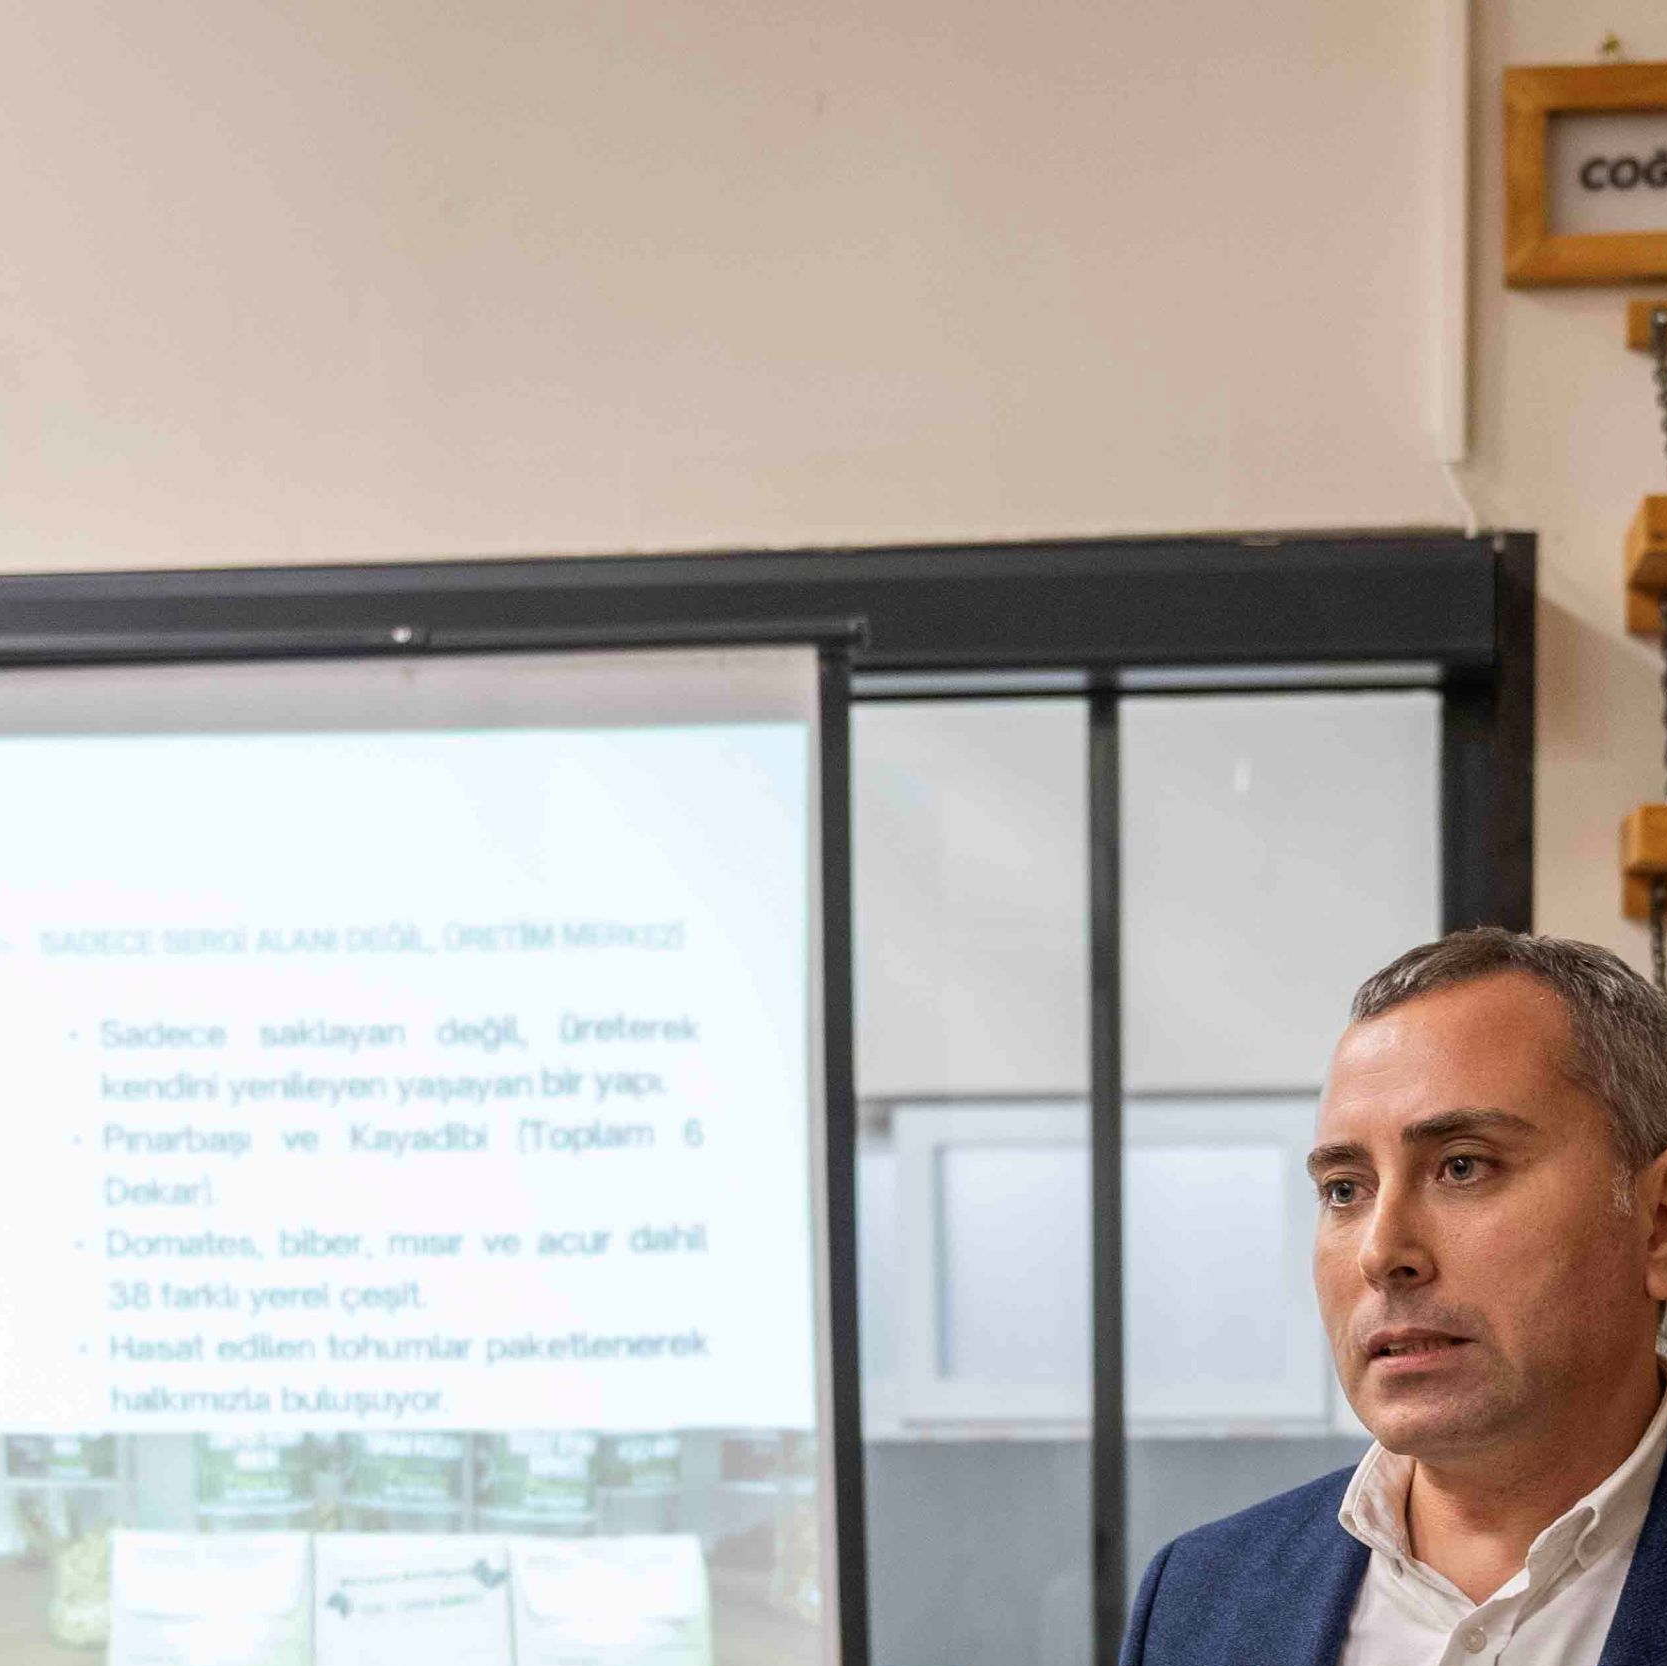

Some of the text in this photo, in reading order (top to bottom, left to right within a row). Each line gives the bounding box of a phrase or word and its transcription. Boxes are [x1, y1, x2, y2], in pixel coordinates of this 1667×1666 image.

[37, 926, 156, 957] SADECE
[256, 926, 339, 955] ALANI
[442, 920, 555, 953] ÜRETİM
[98, 1008, 701, 1053] Sadece saklayan değil, üreterek
[98, 1069, 219, 1102] kendini
[227, 1070, 387, 1108] yenileyen
[396, 1072, 534, 1108] yaşayan
[539, 1066, 582, 1099] bir
[282, 1129, 321, 1153] ve
[348, 1119, 489, 1159] Kayadibi
[680, 1116, 705, 1149] 6
[104, 1222, 708, 1261] Domates, biber, mısır ve acur dahil
[107, 1281, 152, 1312] 38
[159, 1280, 240, 1311] farklı
[248, 1281, 331, 1316] yerel
[109, 1327, 711, 1365] Hasat edilen tohumlar paketlenerek
[109, 1385, 272, 1415] halkımızla
